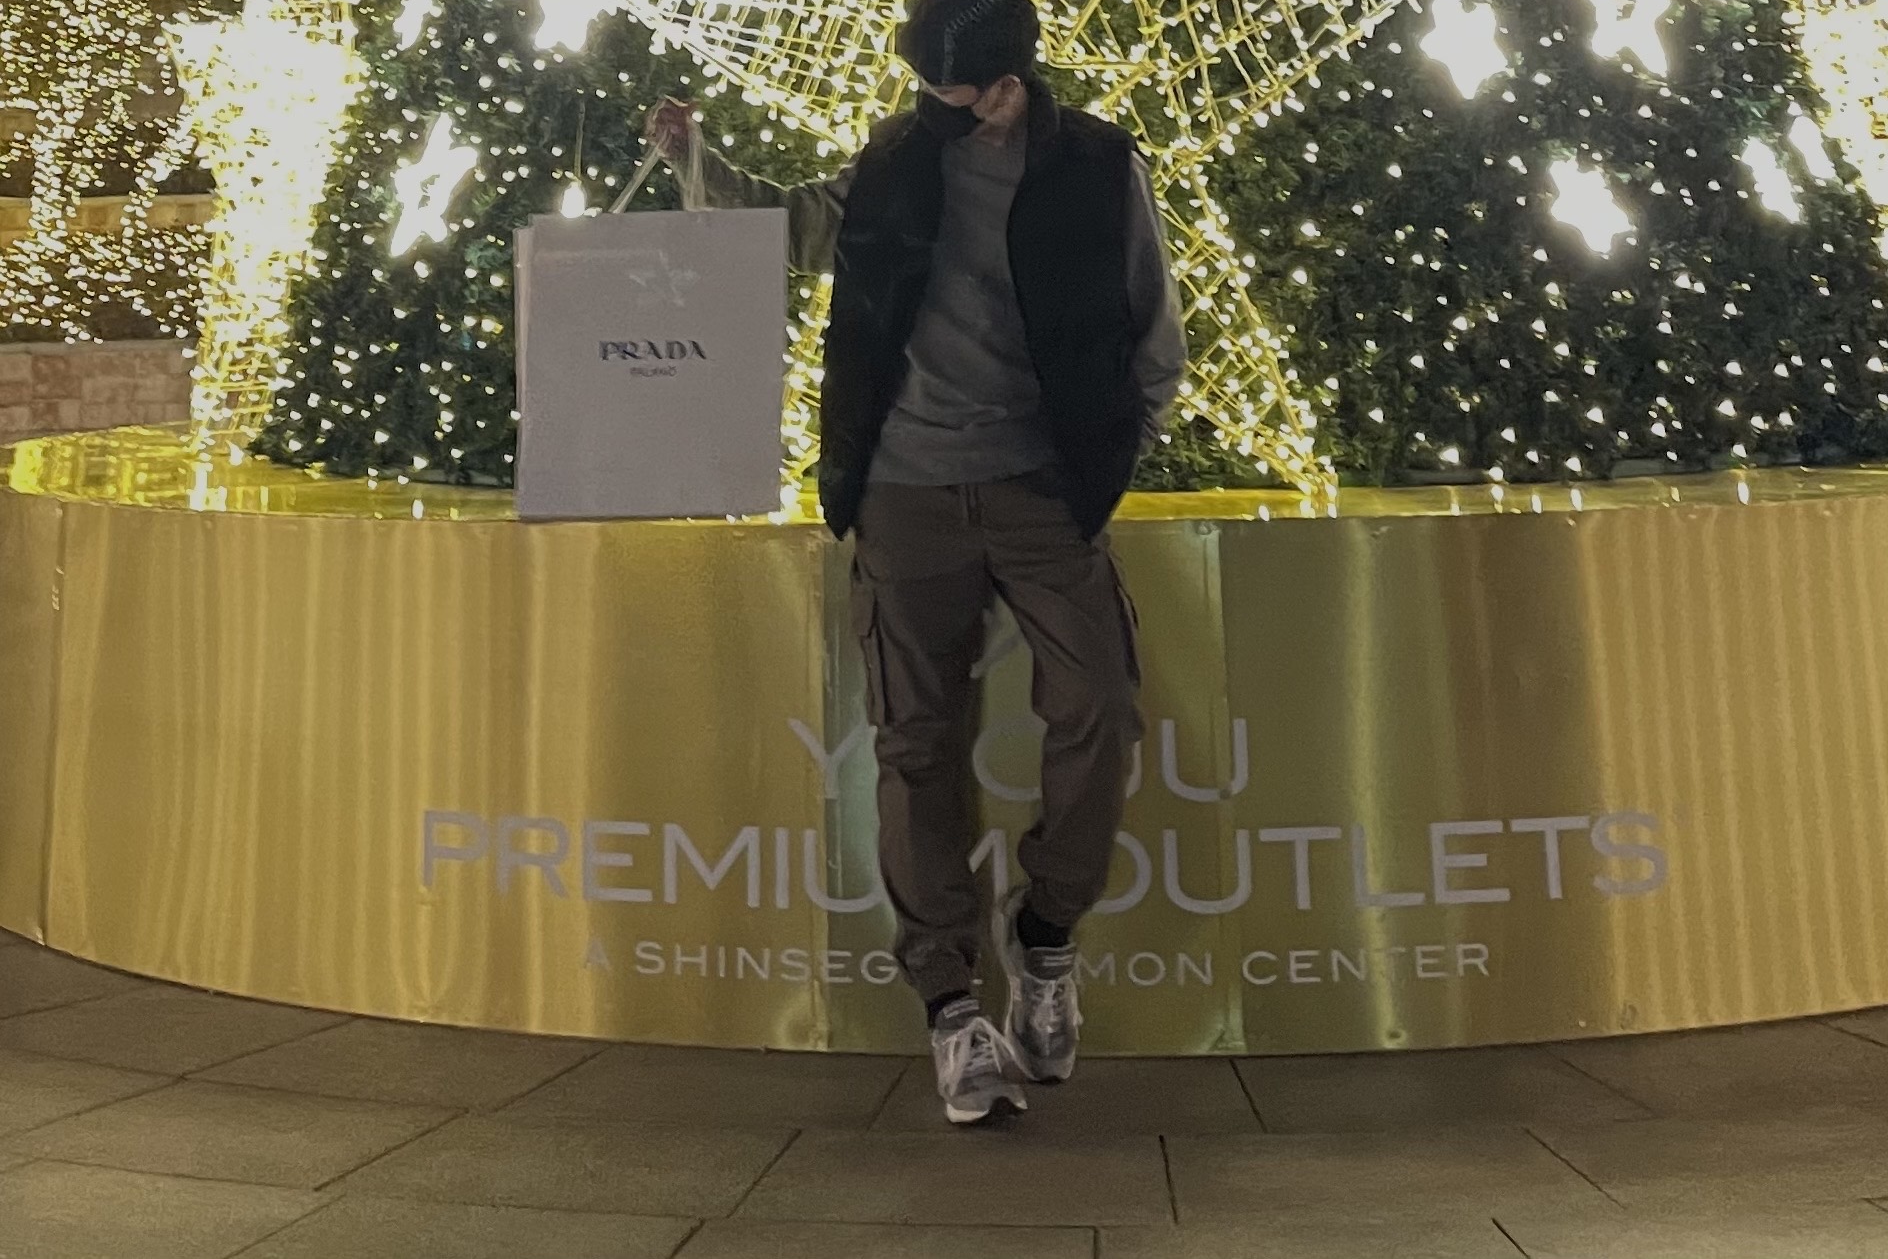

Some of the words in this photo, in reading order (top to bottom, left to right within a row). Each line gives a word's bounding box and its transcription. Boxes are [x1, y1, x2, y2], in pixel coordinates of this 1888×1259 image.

[599, 339, 707, 361] PRADA
[634, 940, 983, 985] SHINSEG
[1241, 943, 1490, 986] CENTER
